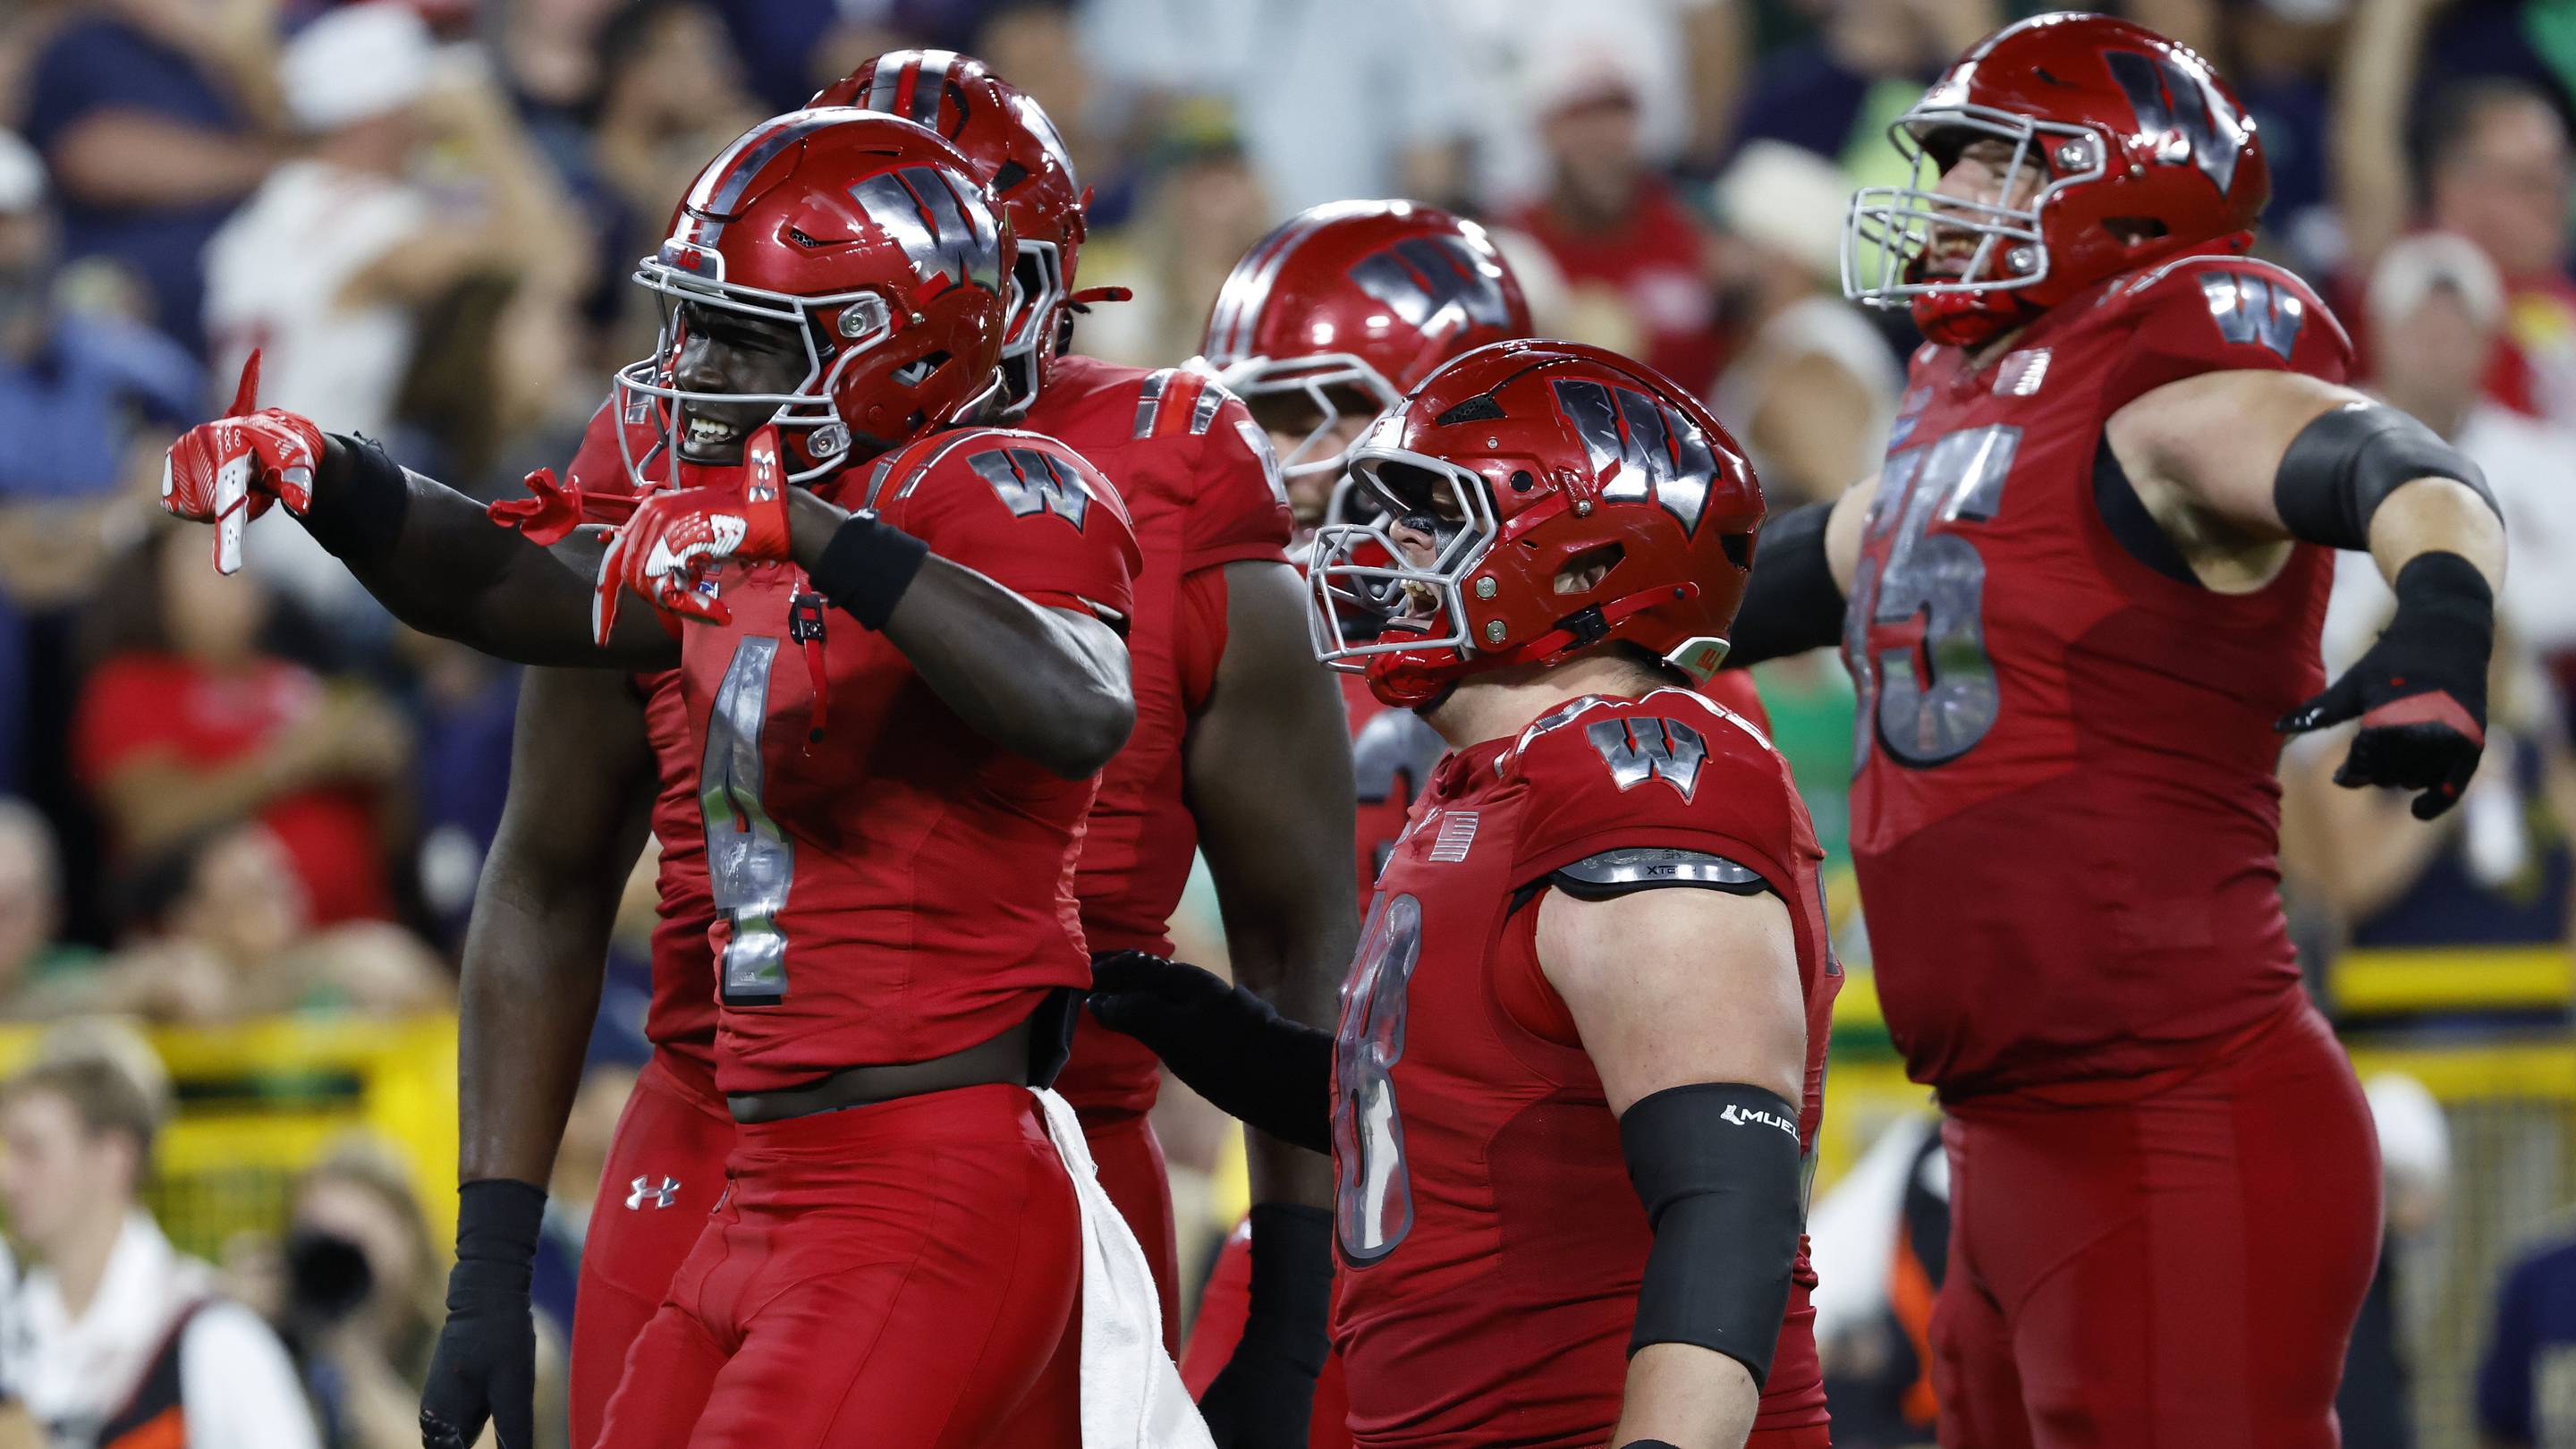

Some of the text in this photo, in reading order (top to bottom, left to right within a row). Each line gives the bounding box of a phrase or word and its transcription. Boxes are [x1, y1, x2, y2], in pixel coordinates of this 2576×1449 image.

[2102, 51, 2243, 202] W
[845, 165, 1003, 301] W
[1346, 233, 1512, 336] W
[2199, 270, 2302, 364] W
[965, 447, 1097, 536] W
[1550, 378, 1721, 543] W
[1582, 716, 1714, 804] W
[699, 633, 795, 1006] 4
[1740, 1108, 1802, 1146] MUEL
